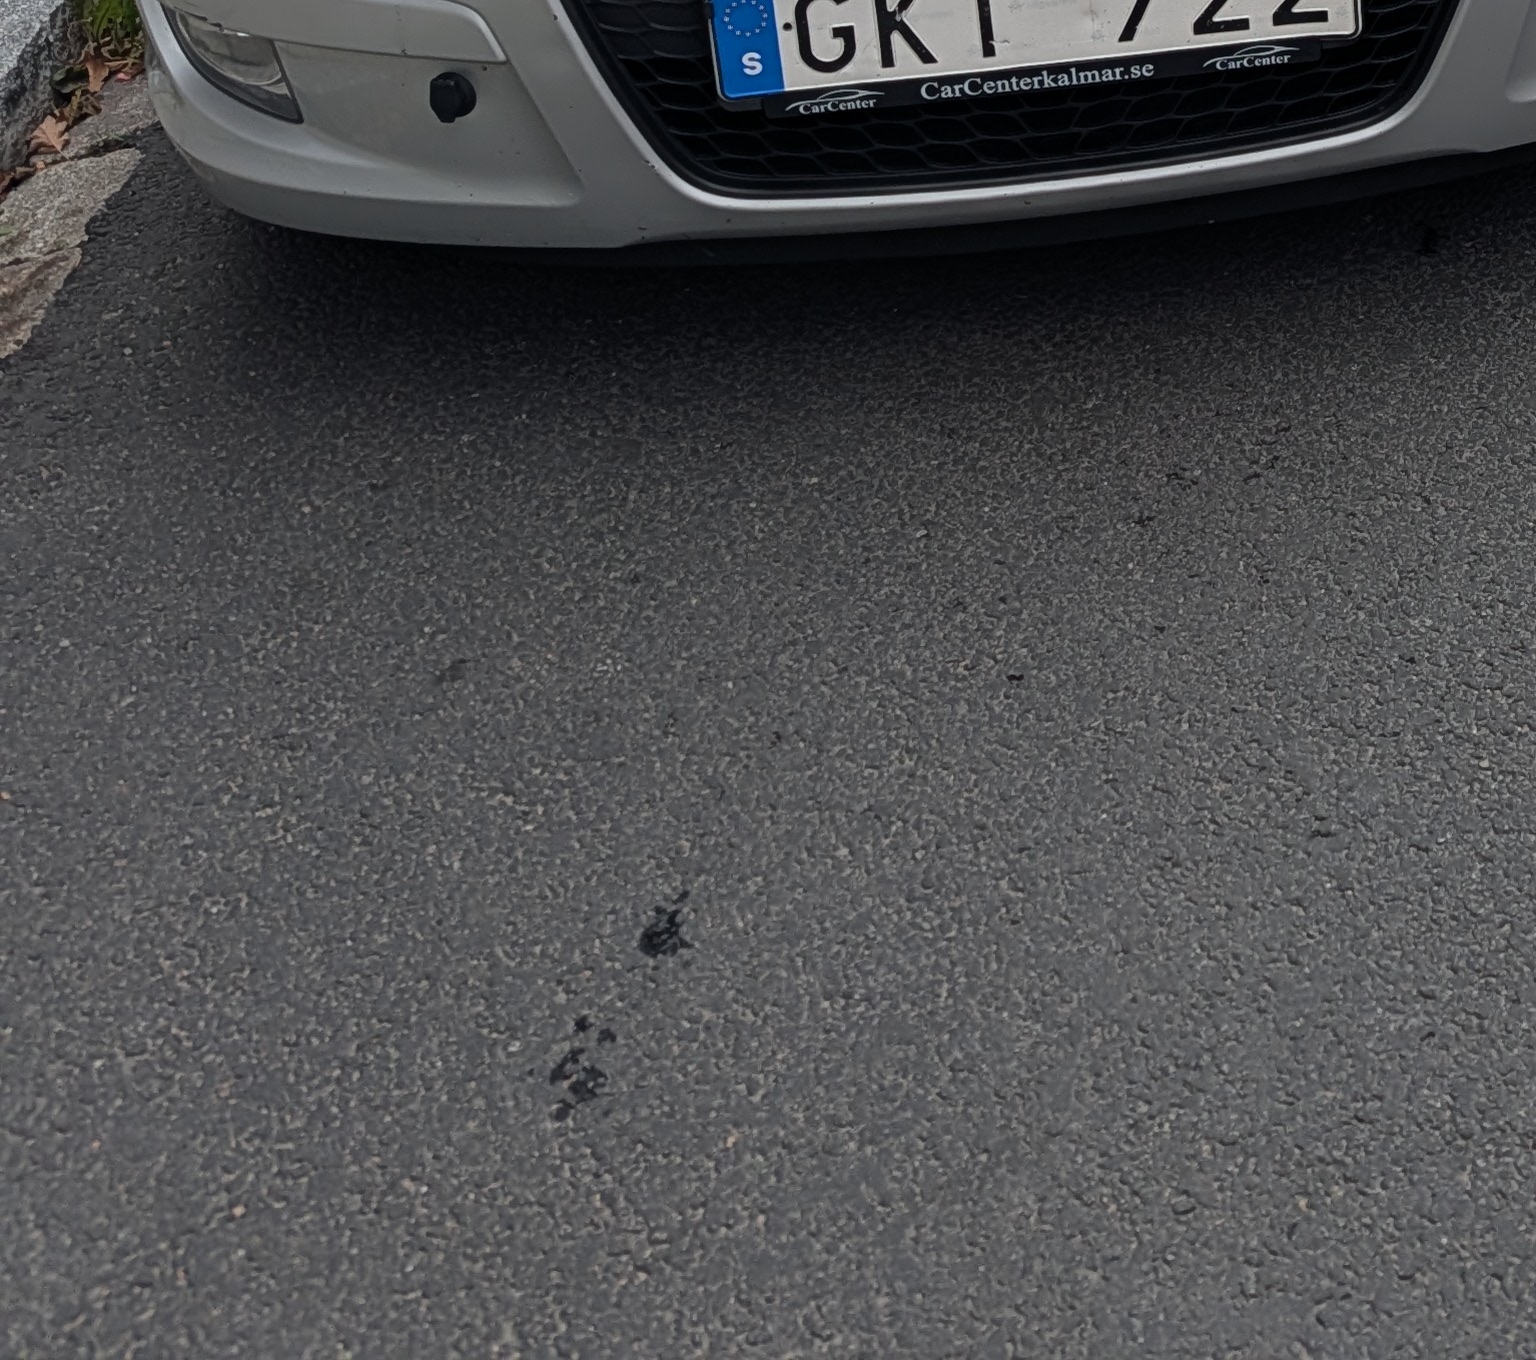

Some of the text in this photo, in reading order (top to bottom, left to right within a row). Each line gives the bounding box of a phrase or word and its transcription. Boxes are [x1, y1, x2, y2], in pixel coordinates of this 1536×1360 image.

[741, 51, 763, 76] S
[1215, 54, 1291, 71] CarCenter
[920, 63, 1155, 100] CarCenterkalmar.se
[799, 99, 876, 115] CarCenter
